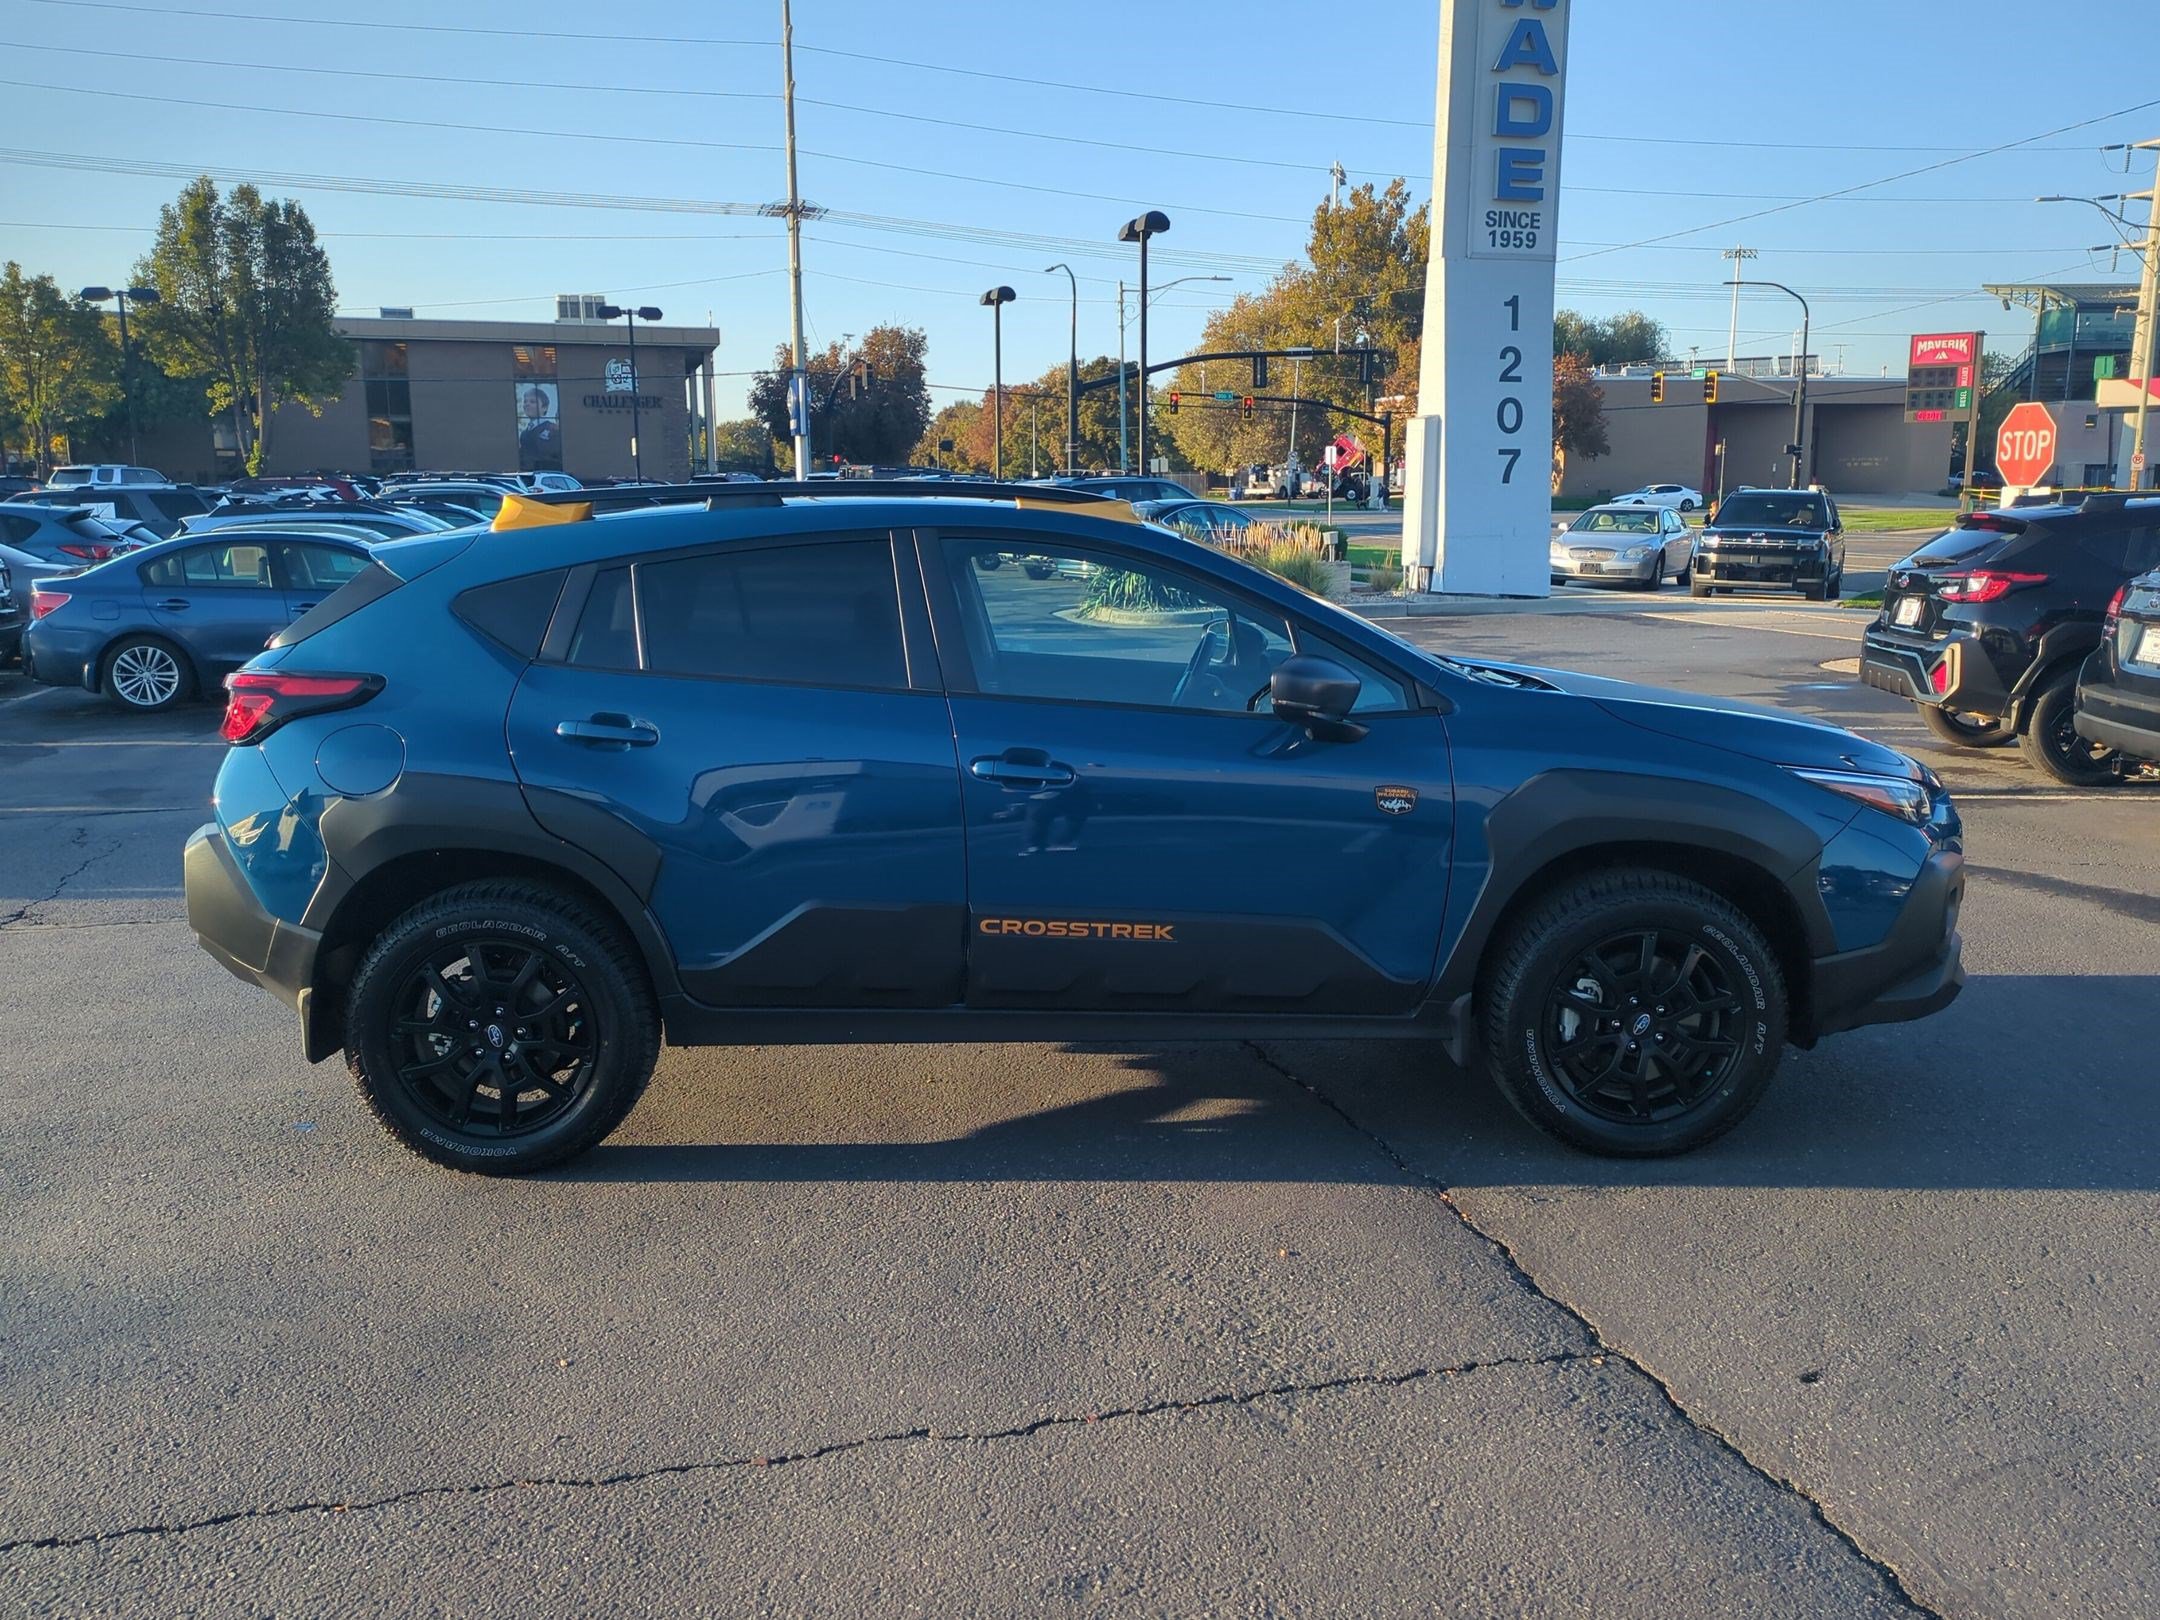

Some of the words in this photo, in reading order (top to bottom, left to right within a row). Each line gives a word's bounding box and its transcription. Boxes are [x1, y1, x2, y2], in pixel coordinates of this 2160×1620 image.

[1490, 0, 1559, 202] ADE
[1485, 210, 1541, 230] SINCE
[1488, 230, 1537, 249] 1959
[1916, 338, 1969, 358] MAVERIK
[1496, 295, 1524, 484] 1207
[2000, 430, 2051, 462] STOP
[436, 920, 547, 942] GEOLANDAR
[979, 919, 1174, 940] CROSSTREK
[1702, 925, 1766, 1010] GEOLANDAR
[1526, 1029, 1567, 1114] YOKOHAMA
[420, 1127, 518, 1157] YOKOHAMA
